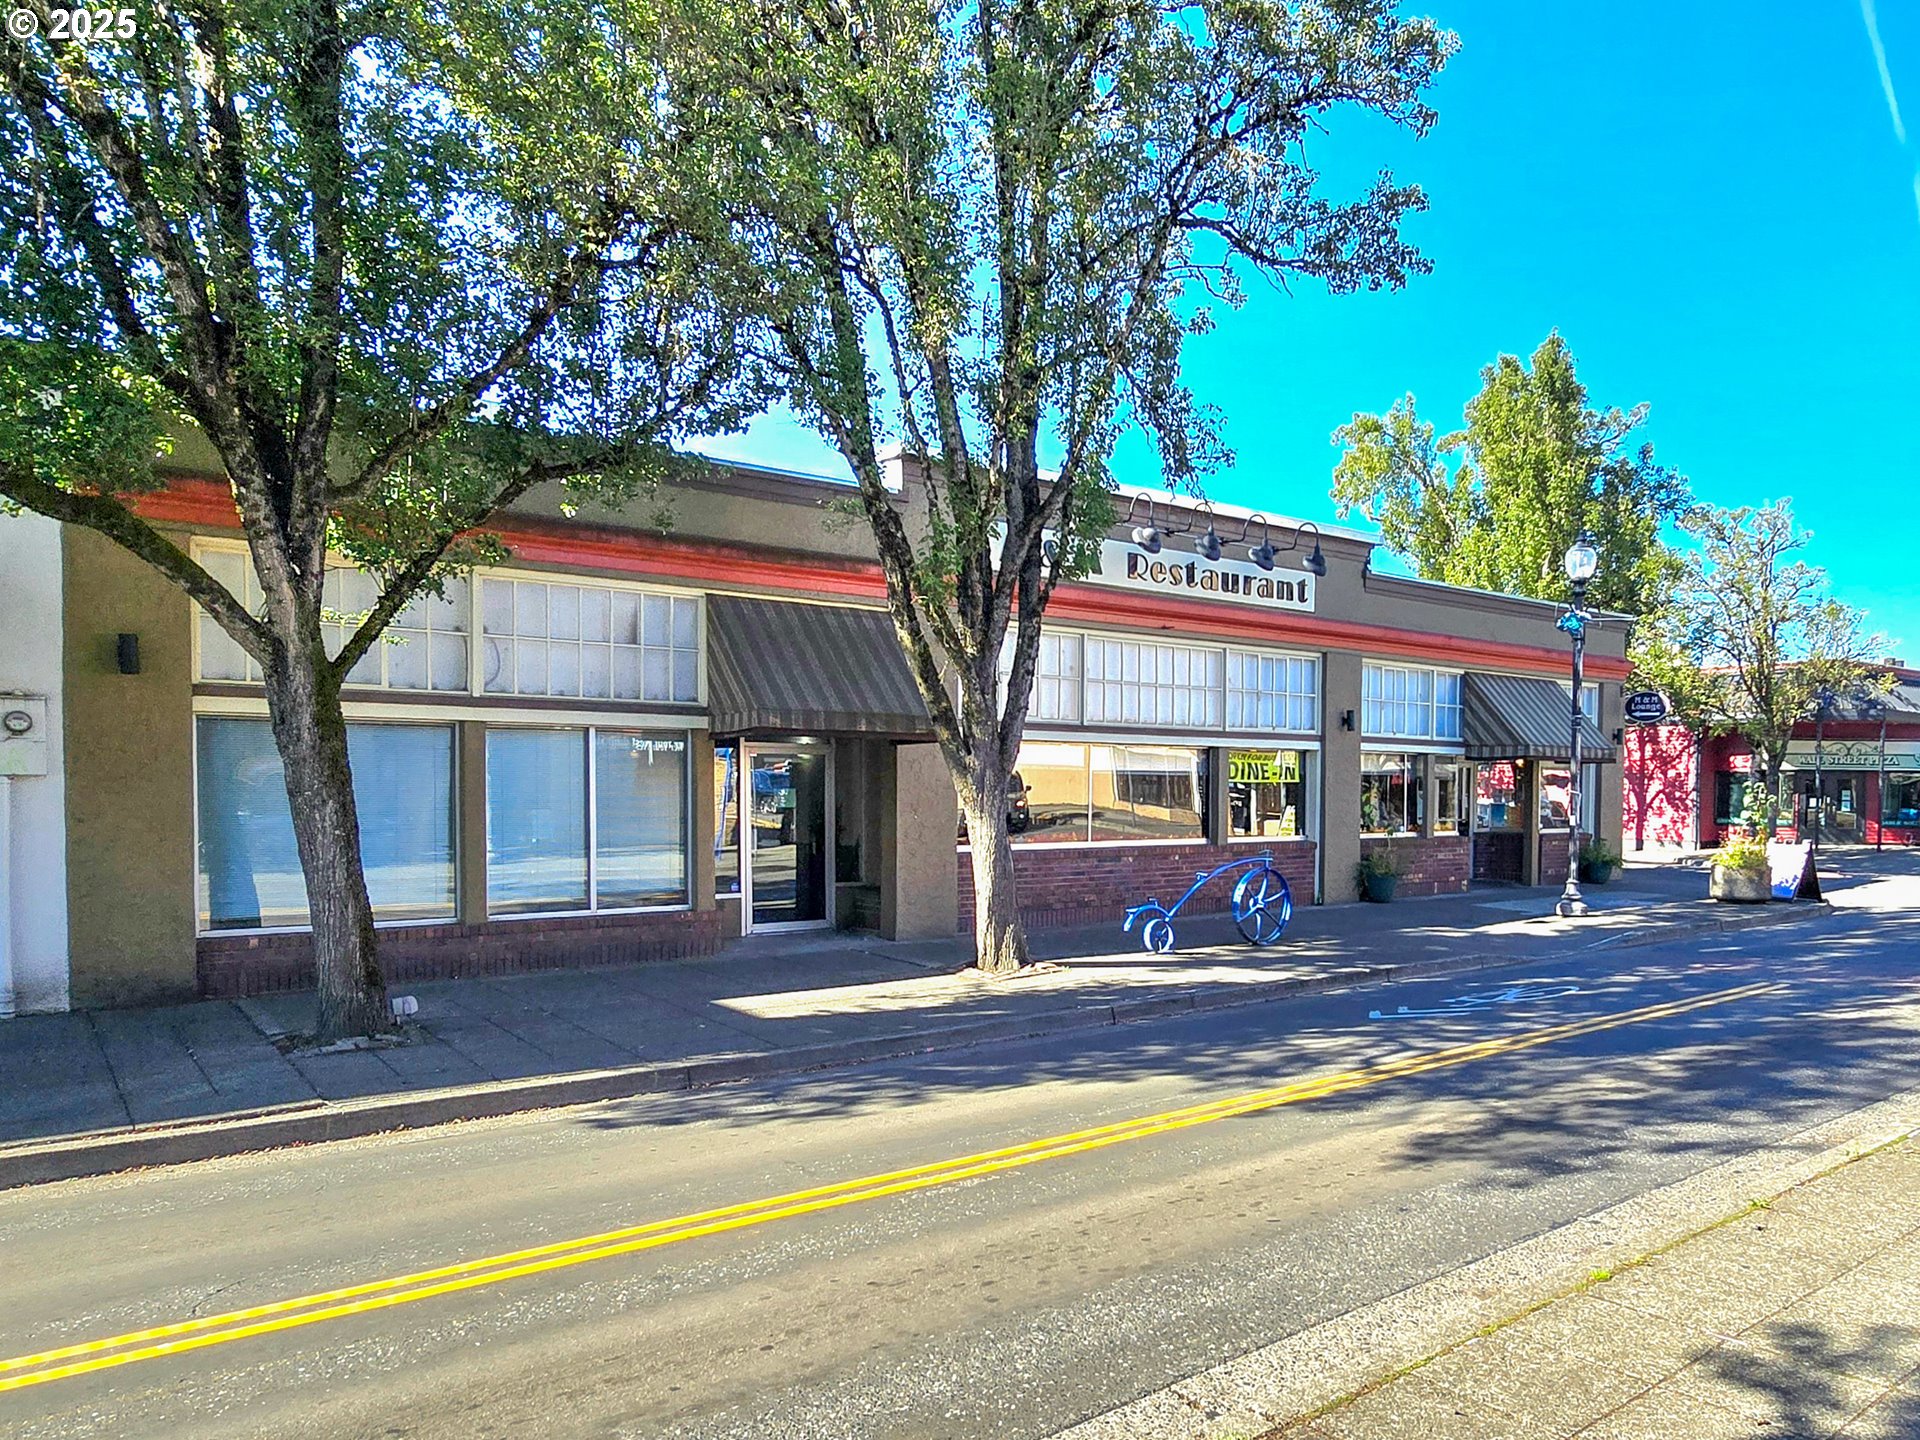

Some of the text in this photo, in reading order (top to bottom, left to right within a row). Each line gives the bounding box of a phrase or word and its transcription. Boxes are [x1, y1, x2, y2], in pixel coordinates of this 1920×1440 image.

[1127, 552, 1308, 603] Restaurant
[1635, 696, 1641, 704] M
[1631, 703, 1661, 711] Lounge
[1828, 755, 1867, 766] STREET
[1868, 756, 1900, 766] PIZA
